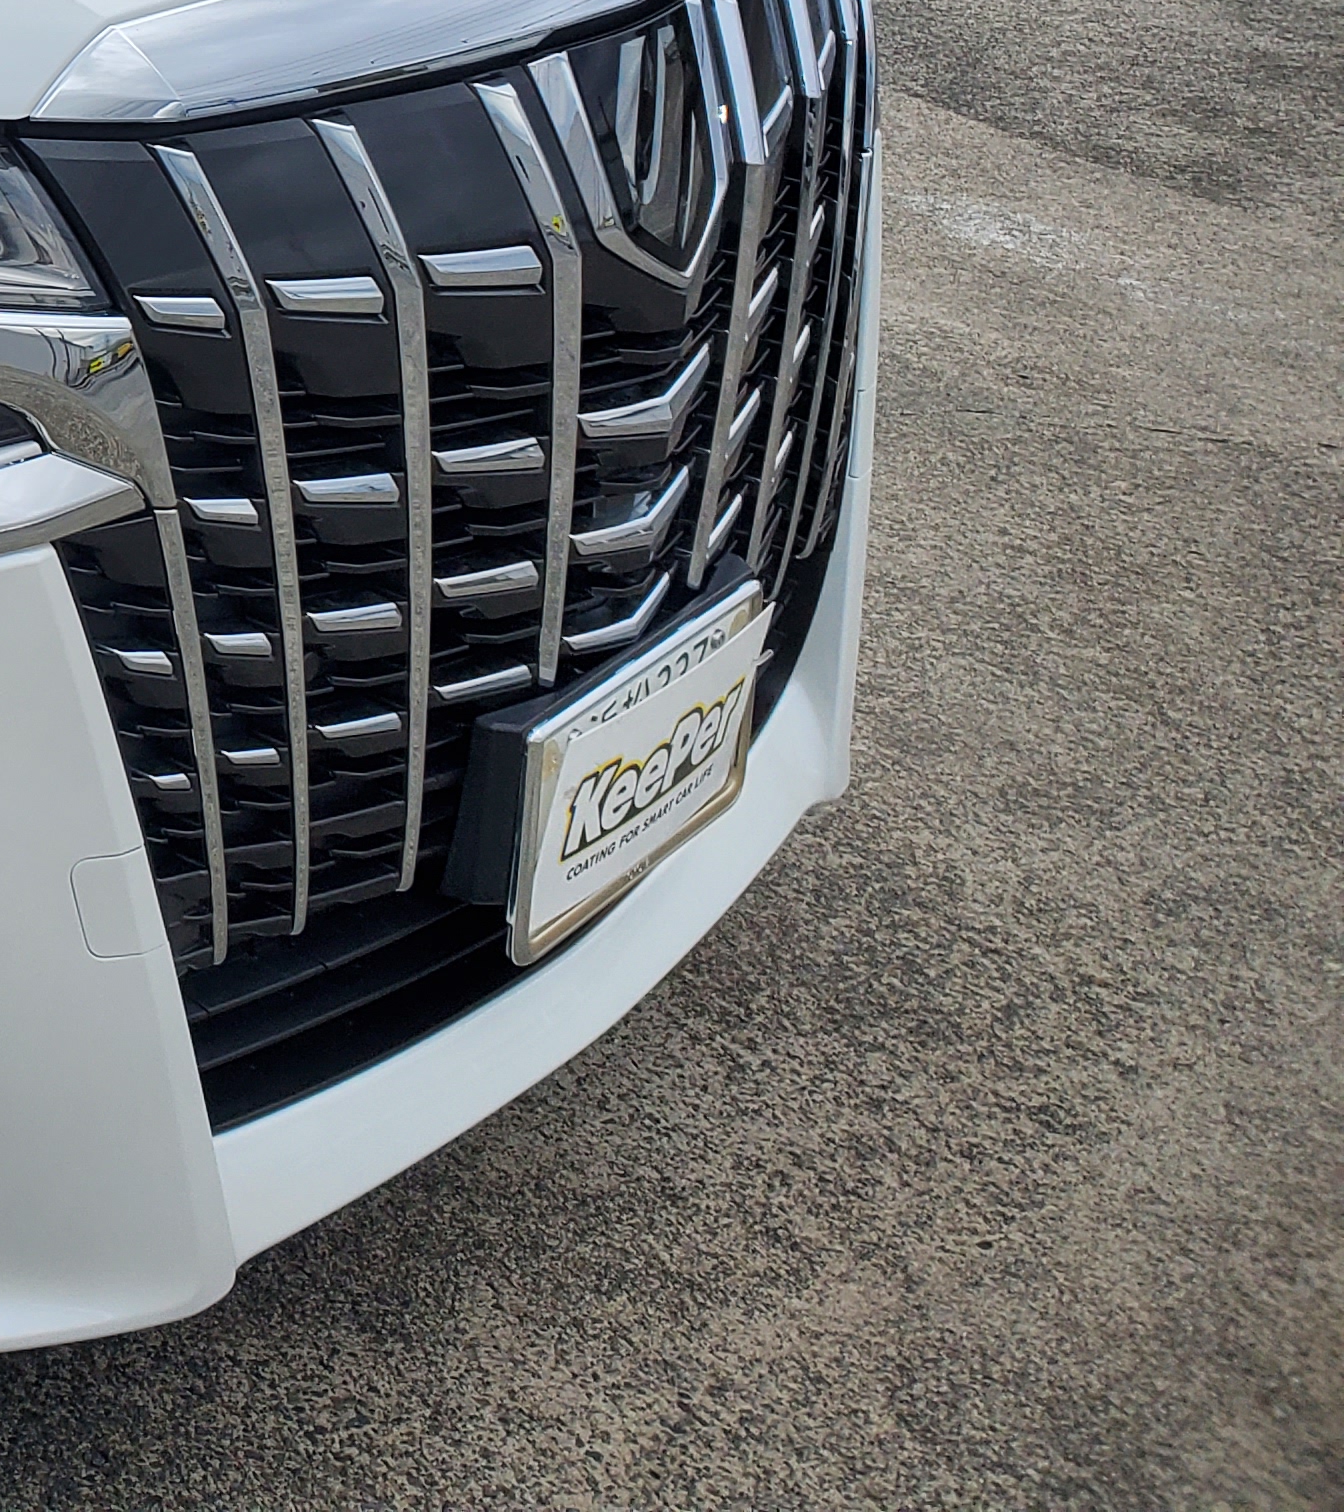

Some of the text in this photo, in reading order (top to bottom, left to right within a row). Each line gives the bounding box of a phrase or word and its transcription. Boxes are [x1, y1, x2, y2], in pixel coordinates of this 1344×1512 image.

[560, 674, 746, 864] KeePer
[566, 841, 617, 881] COATING
[619, 823, 641, 848] FOR
[642, 798, 676, 834] SMART
[676, 783, 693, 806] CAR
[692, 762, 715, 792] LIFE
